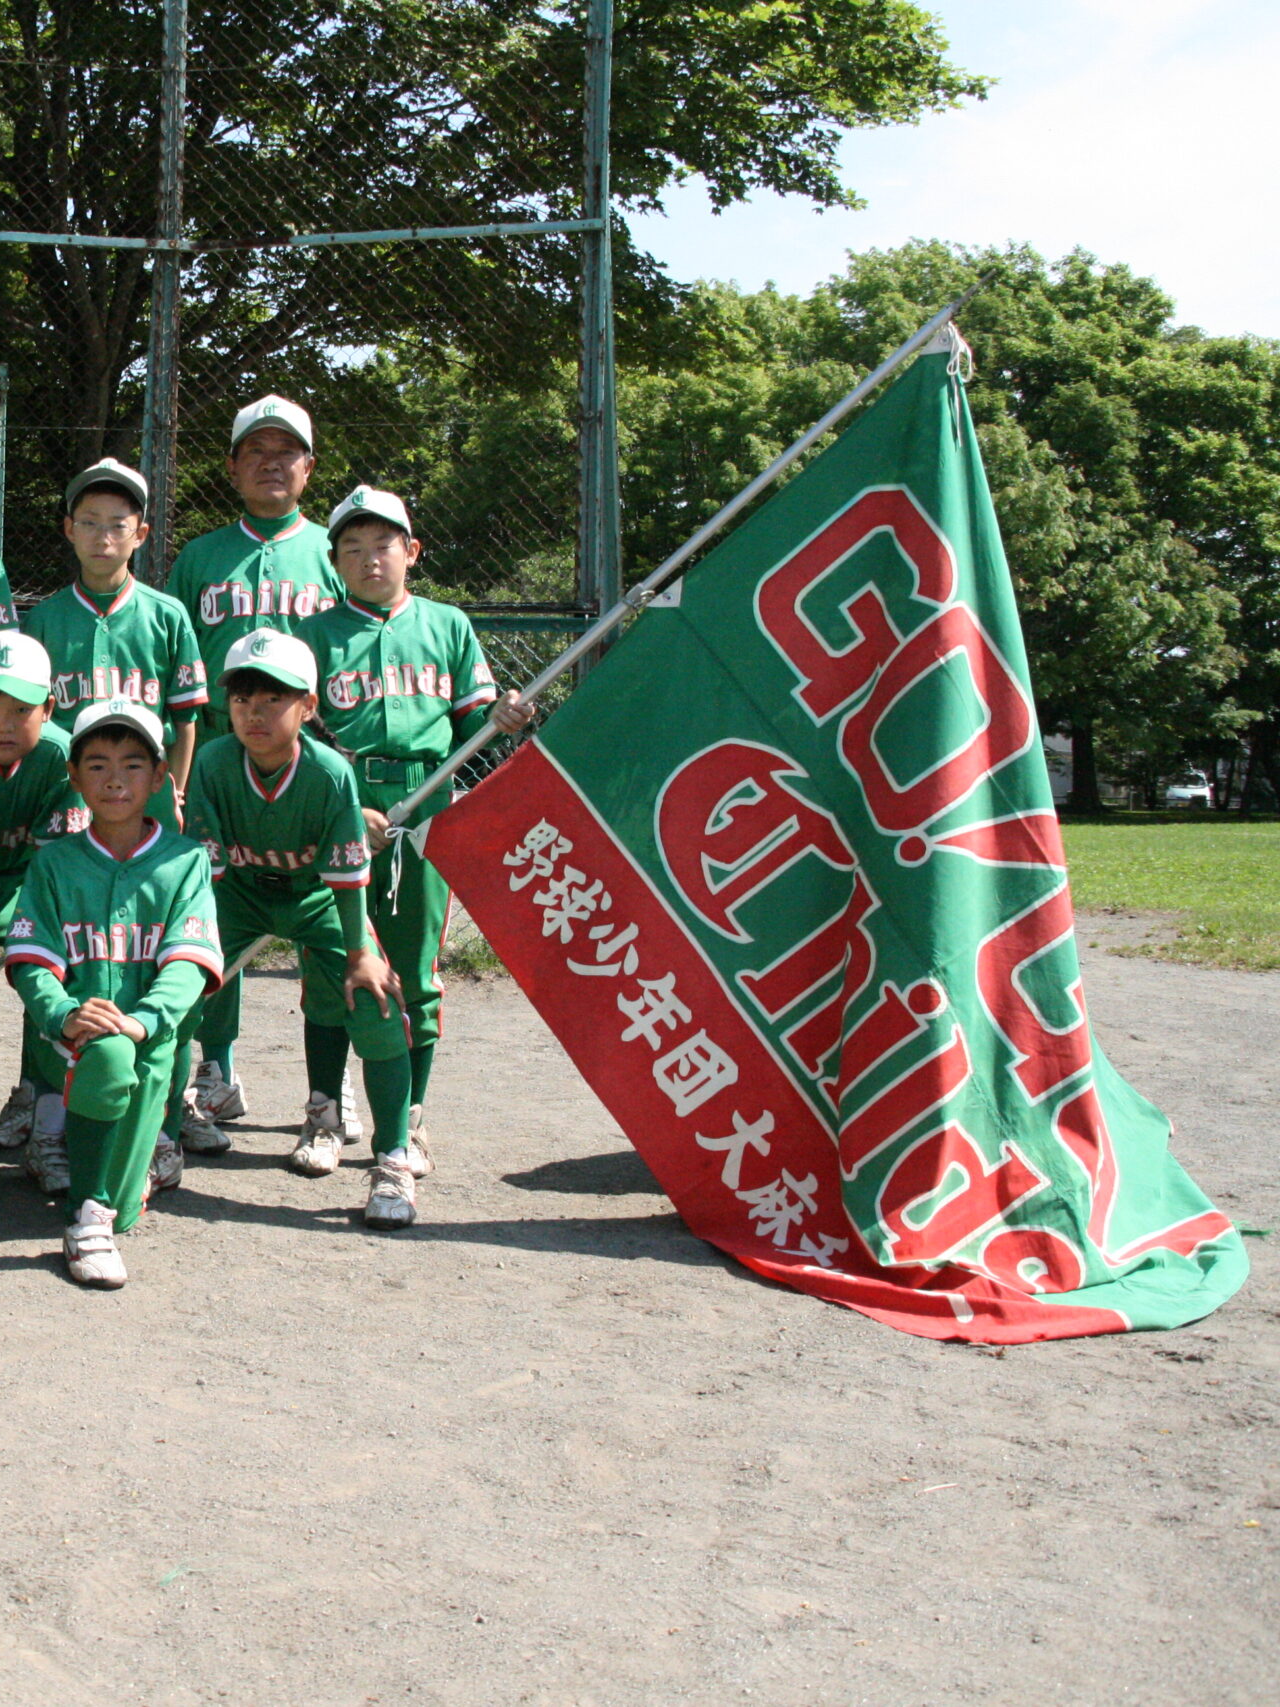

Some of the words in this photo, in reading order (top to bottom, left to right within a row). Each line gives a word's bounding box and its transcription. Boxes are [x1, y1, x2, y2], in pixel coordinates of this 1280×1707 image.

[52, 666, 160, 710] Childs
[326, 663, 454, 711] Childs
[7, 918, 33, 939] 麻
